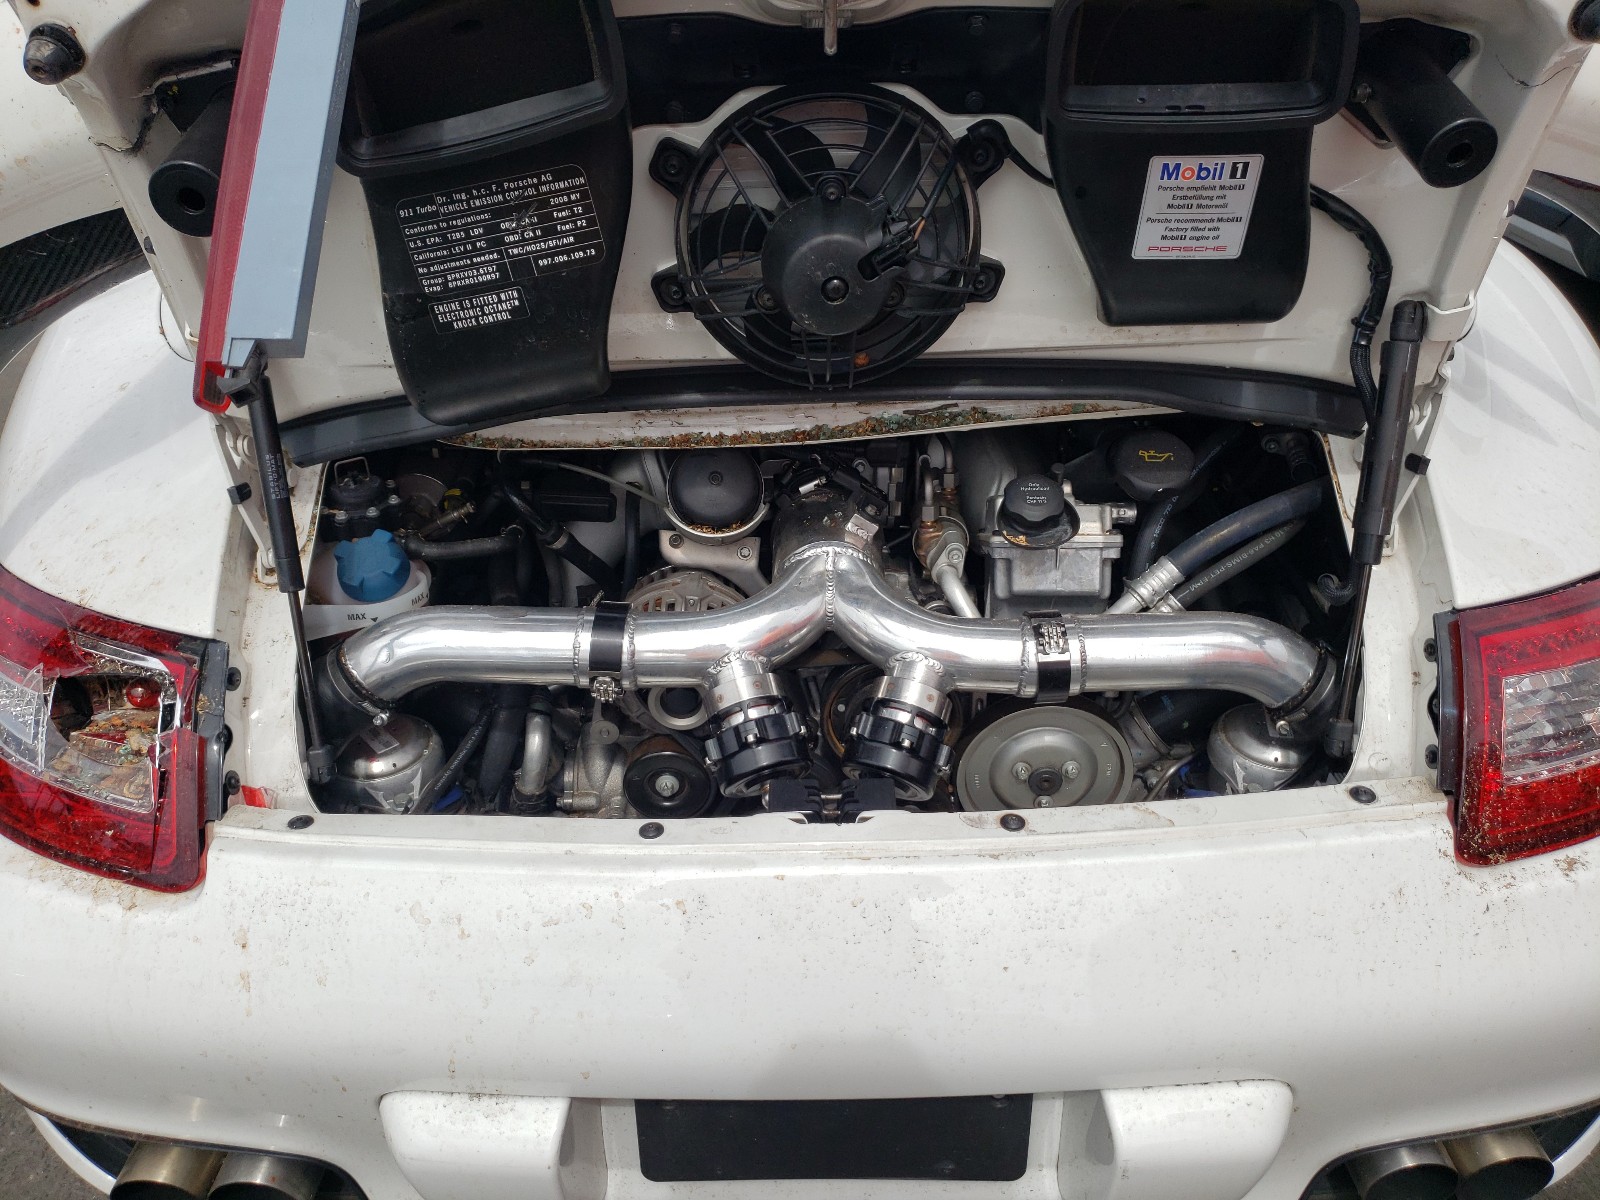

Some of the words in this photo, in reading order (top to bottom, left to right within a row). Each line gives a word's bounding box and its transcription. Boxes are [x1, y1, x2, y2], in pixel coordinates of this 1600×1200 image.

[1160, 162, 1225, 181] Mobil
[436, 196, 450, 204] Dr.
[452, 192, 470, 201] Ing.
[491, 184, 501, 192] F.
[503, 177, 538, 190] Porsche
[541, 173, 552, 182] AG
[439, 201, 468, 214] VEHICLE
[470, 194, 504, 208] EMISSION
[538, 176, 585, 193] INFORMATION
[1186, 185, 1217, 193] empfiehlt
[549, 195, 568, 205] 2008
[570, 192, 581, 201] MY
[400, 209, 413, 218] 911
[416, 204, 437, 214] Turbo
[553, 209, 571, 219] Fuel:
[573, 206, 583, 214] T2
[404, 224, 437, 235] Conforms
[439, 220, 447, 228] to
[449, 212, 492, 226] regulations:
[557, 222, 575, 232] Fuel:
[576, 219, 587, 227] P2
[409, 240, 425, 248] U.S.
[426, 236, 443, 245] EPA:
[469, 227, 484, 237] LDV
[504, 233, 522, 243] OBD:
[524, 230, 534, 239] CA
[413, 249, 450, 261] California:
[451, 245, 464, 254] LEV
[476, 240, 487, 249] PC
[1147, 245, 1228, 253] PORSCHE
[417, 266, 428, 274] No
[429, 258, 471, 272] adjustments
[472, 252, 501, 263] needed.
[538, 248, 596, 267] 997.006.109.73
[422, 276, 445, 286] Group:
[424, 284, 444, 293] Evap:
[434, 301, 461, 314] ENGINE
[462, 300, 471, 308] IS
[472, 294, 498, 307] FITTED
[500, 290, 519, 301] WITH
[437, 308, 482, 323] ELECTRONIC
[453, 318, 477, 330] KNOCK
[478, 311, 512, 325] CONTROL
[411, 592, 425, 606] MAX
[347, 612, 367, 621] MAX
